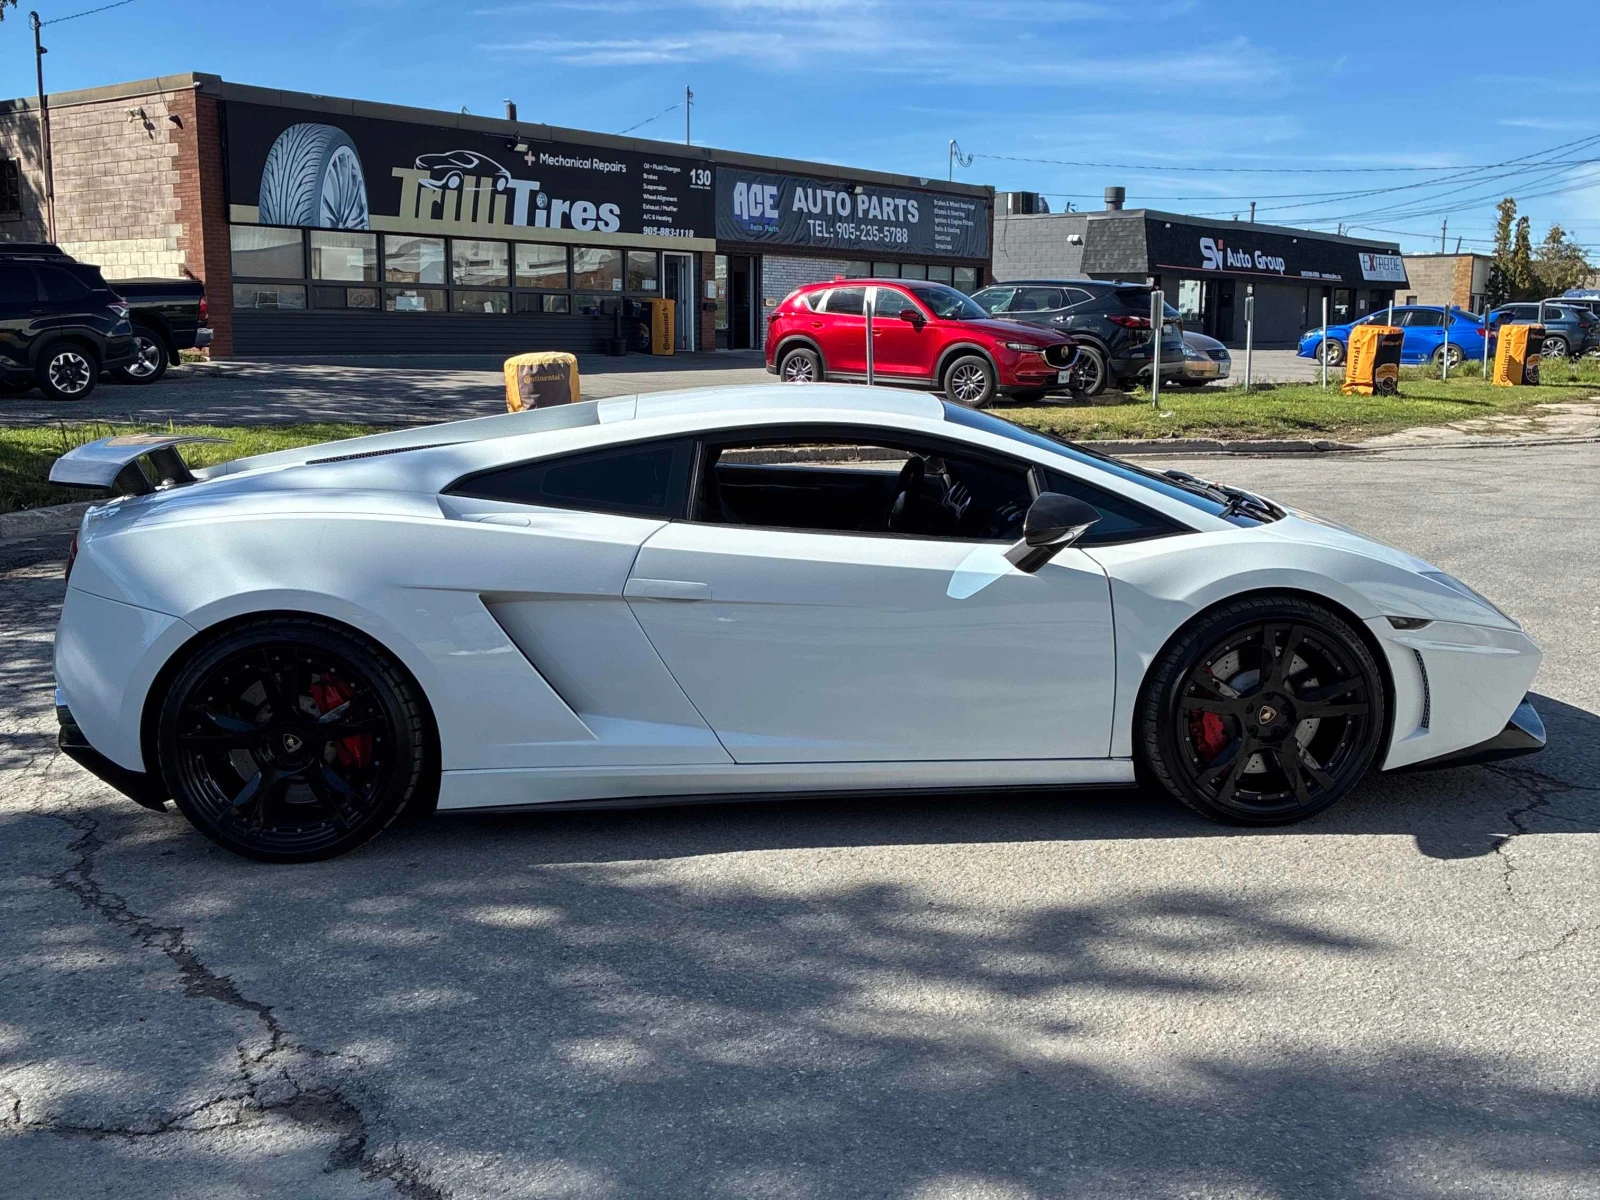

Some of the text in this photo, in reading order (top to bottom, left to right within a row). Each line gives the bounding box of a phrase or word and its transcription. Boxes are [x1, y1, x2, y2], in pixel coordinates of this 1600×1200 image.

[539, 152, 627, 174] Mechanical Repairs
[664, 165, 681, 173] Changes
[689, 168, 711, 186] 130
[657, 194, 678, 203] Alignment
[733, 181, 779, 220] ACE
[792, 186, 919, 224] AUTO PARTS
[643, 203, 660, 211] Exhaust
[656, 215, 672, 223] Heating
[643, 226, 694, 237] 905-883-1118
[764, 225, 780, 233] Parts
[807, 219, 909, 244] TEL: 905-235-5788
[1226, 247, 1252, 269] Auto
[1254, 250, 1286, 276] Group
